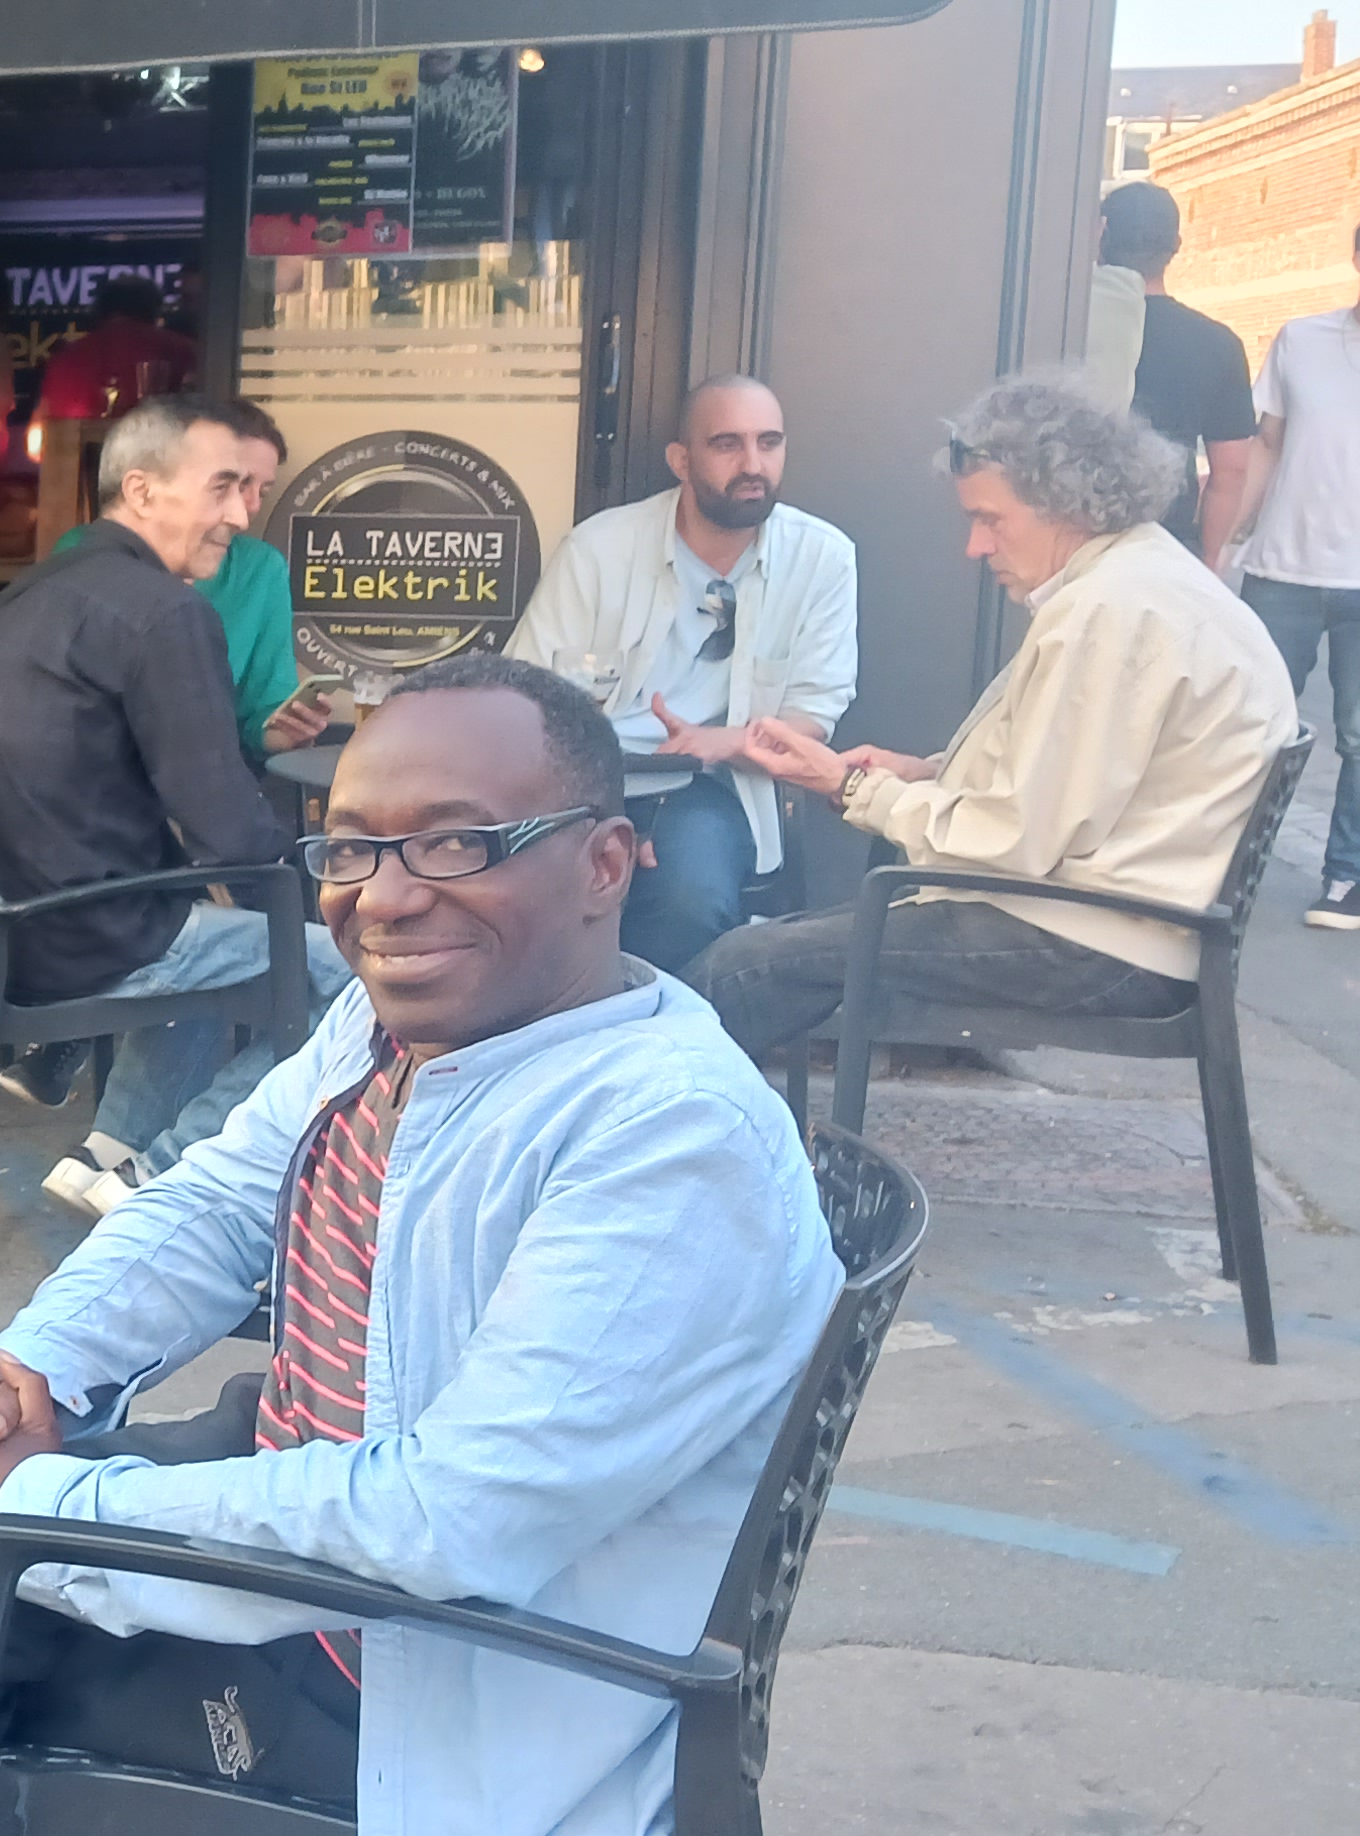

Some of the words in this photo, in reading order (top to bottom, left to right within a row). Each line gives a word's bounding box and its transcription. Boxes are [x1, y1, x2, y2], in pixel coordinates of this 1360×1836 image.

[394, 441, 478, 472] CONCERTS
[489, 479, 516, 510] MIX
[307, 530, 344, 557] LA
[304, 566, 498, 602] Elektrik
[297, 628, 358, 677] OUVERT
